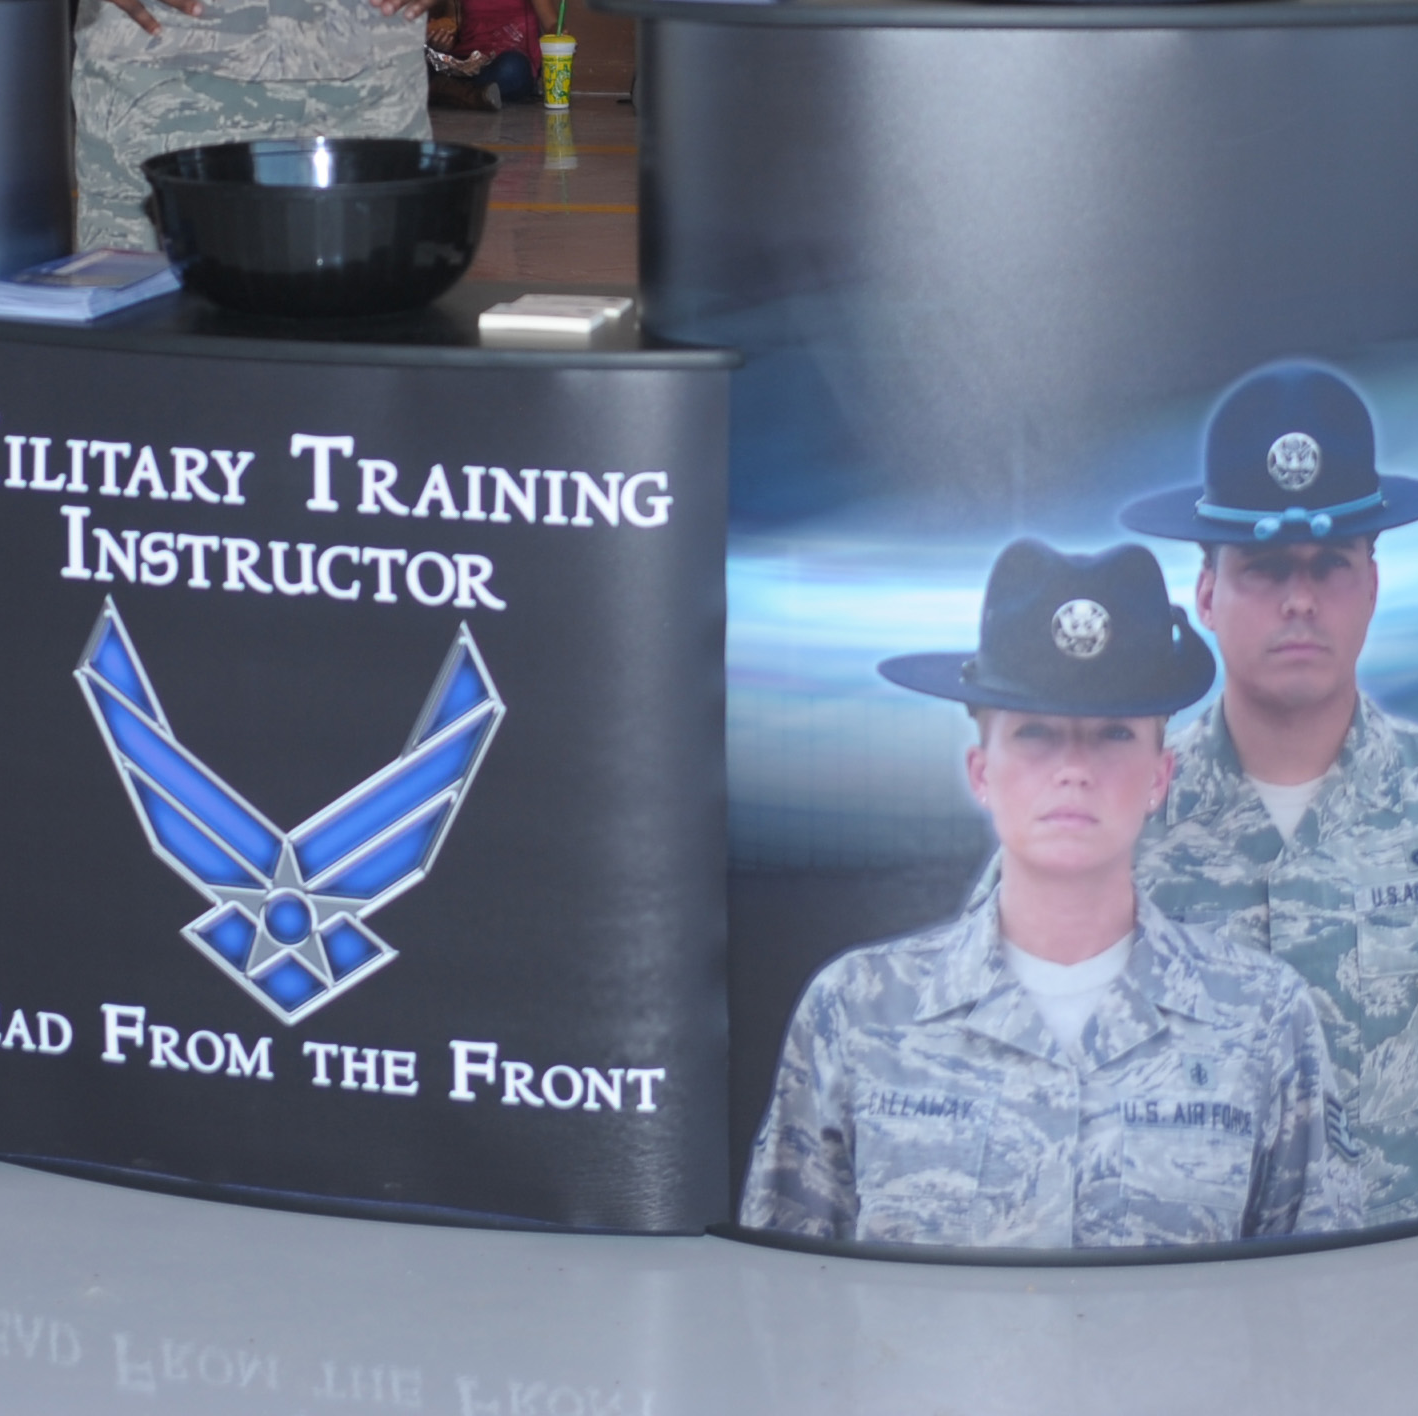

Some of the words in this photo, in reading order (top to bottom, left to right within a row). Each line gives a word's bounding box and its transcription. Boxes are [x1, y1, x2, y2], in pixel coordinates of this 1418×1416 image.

[290, 432, 674, 528] TRAINING
[60, 504, 507, 611] INSTRUCTOR
[100, 1003, 275, 1080] FROM
[303, 1040, 419, 1096] THE
[448, 1039, 666, 1113] FRONT
[868, 1091, 975, 1121] CALLAWAY
[1124, 1101, 1166, 1124] U.S.
[1173, 1101, 1205, 1125] AIR
[1212, 1103, 1253, 1136] FORCE
